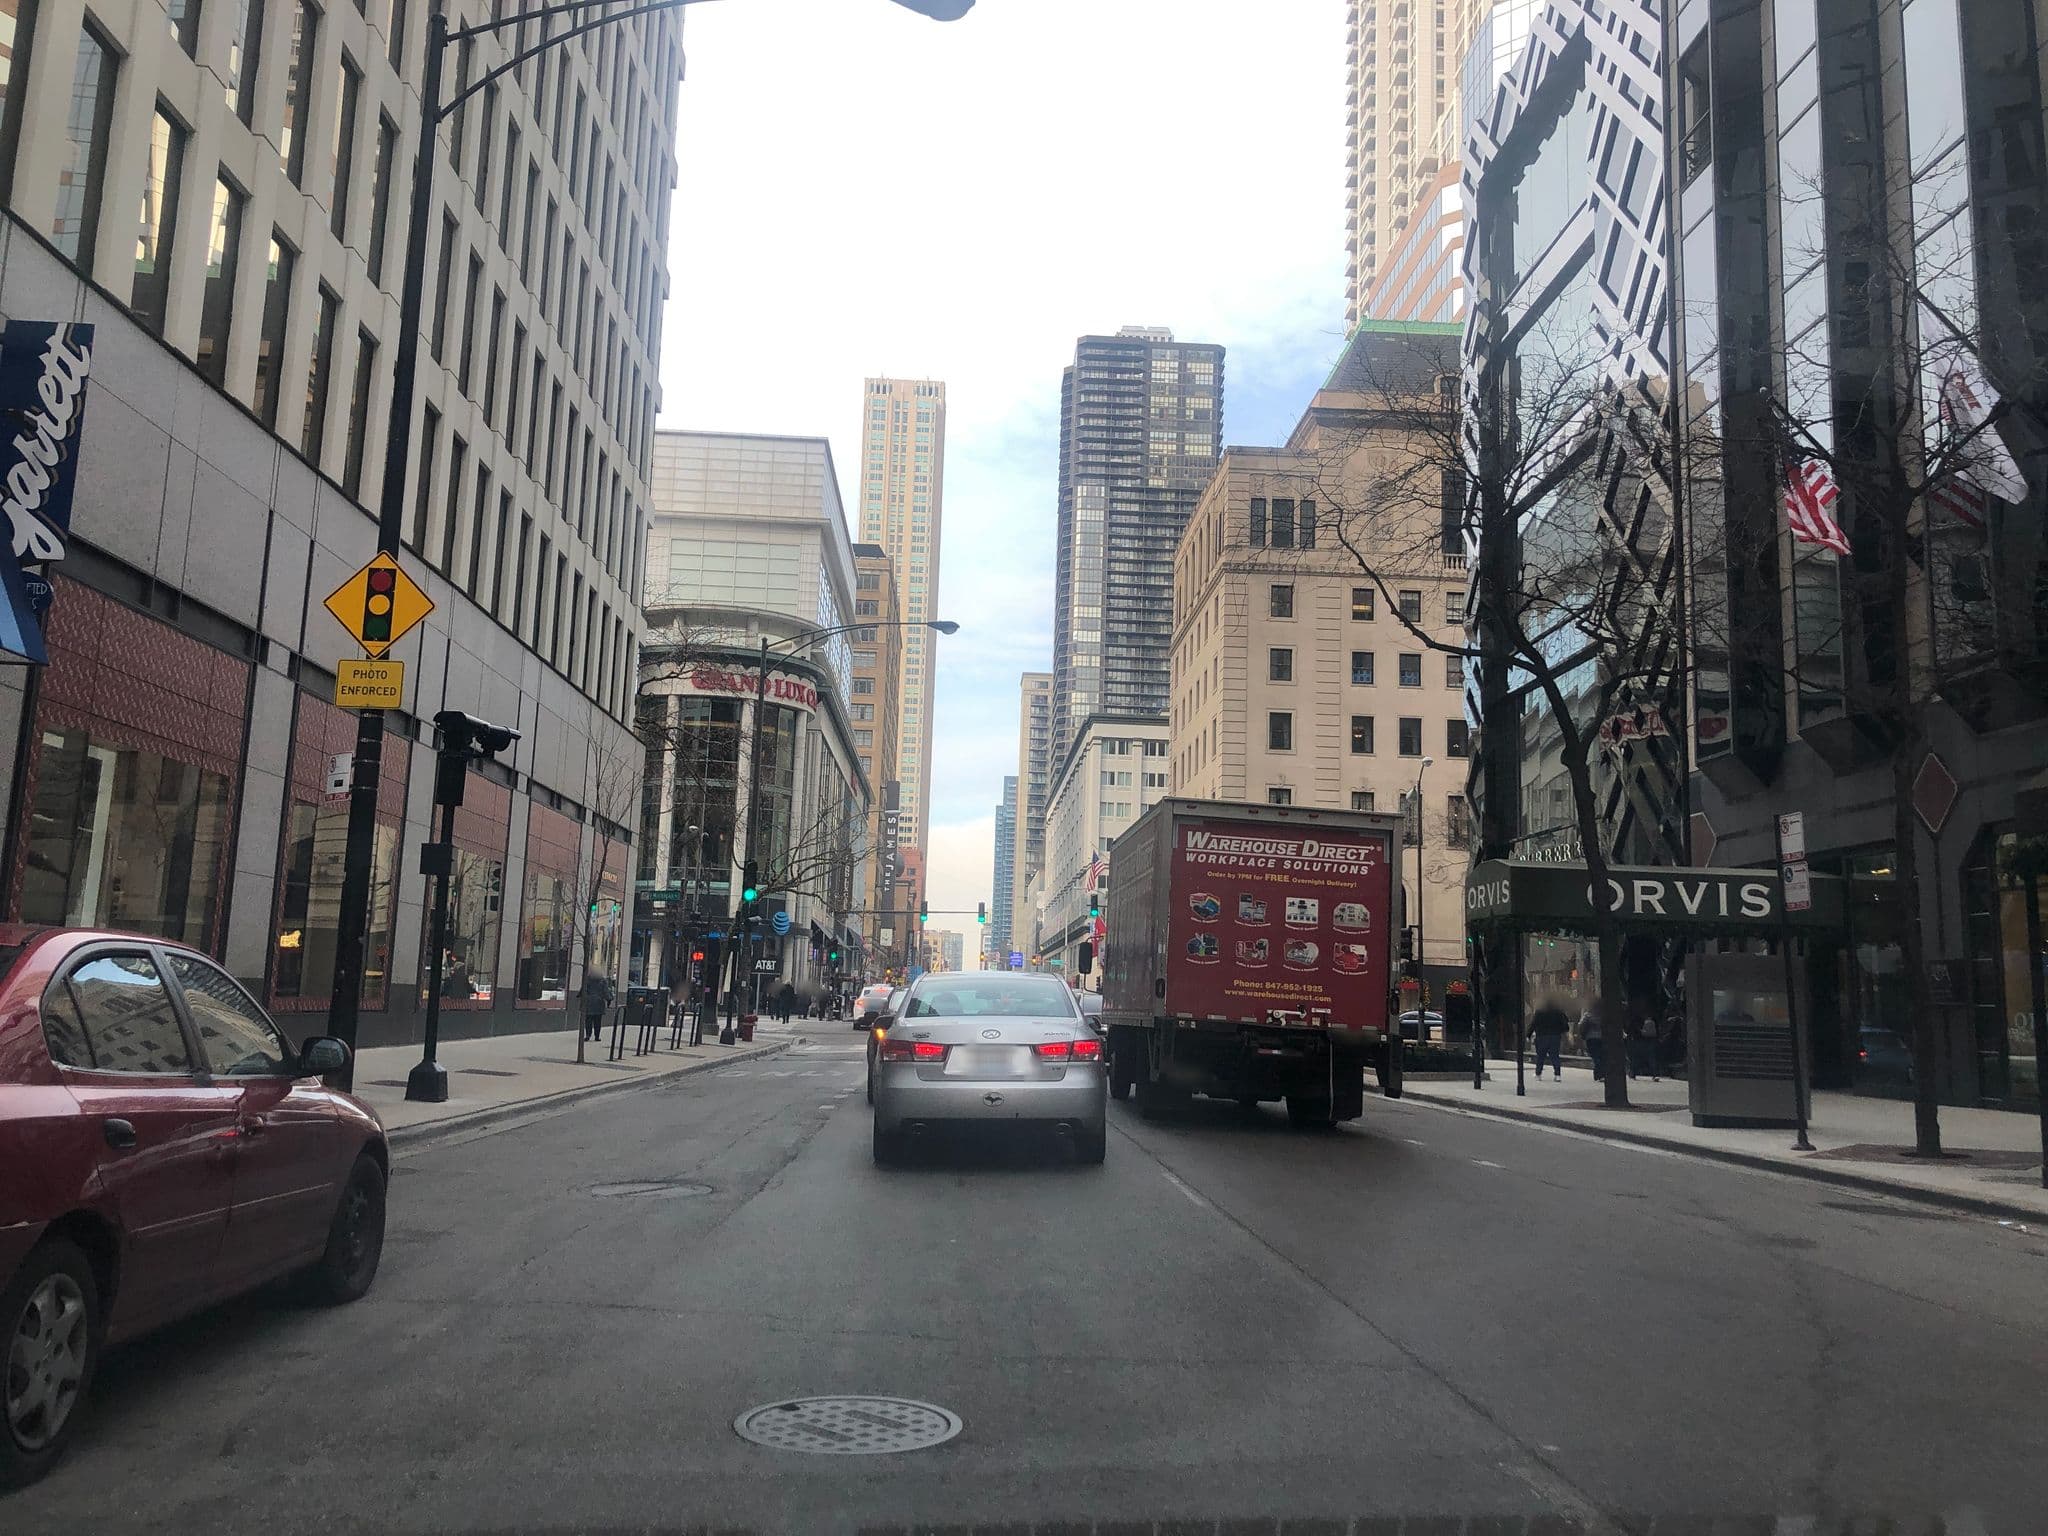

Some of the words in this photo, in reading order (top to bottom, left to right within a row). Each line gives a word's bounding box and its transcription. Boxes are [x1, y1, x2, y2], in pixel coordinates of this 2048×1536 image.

[352, 669, 388, 680] PHOTO
[340, 685, 397, 696] ENFORCED
[692, 669, 772, 696] GAND
[774, 679, 807, 703] LUX
[885, 817, 897, 871] JAMES
[1187, 831, 1298, 856] WAREHOUSE
[1301, 839, 1369, 861] DIRECT
[1186, 852, 1277, 868] WORKPLACE
[1283, 859, 1369, 875] SOLUTIONS
[1207, 870, 1226, 878] Order
[1227, 872, 1236, 880] by
[1264, 873, 1290, 883] FREE
[1292, 877, 1325, 886] Overnight
[1468, 879, 1511, 909] ORVIS
[1587, 878, 1772, 918] ORVIS
[755, 959, 777, 971] AT&T
[1233, 979, 1263, 989] Phone:
[1224, 989, 1332, 1003] www.warehousedirect.com
